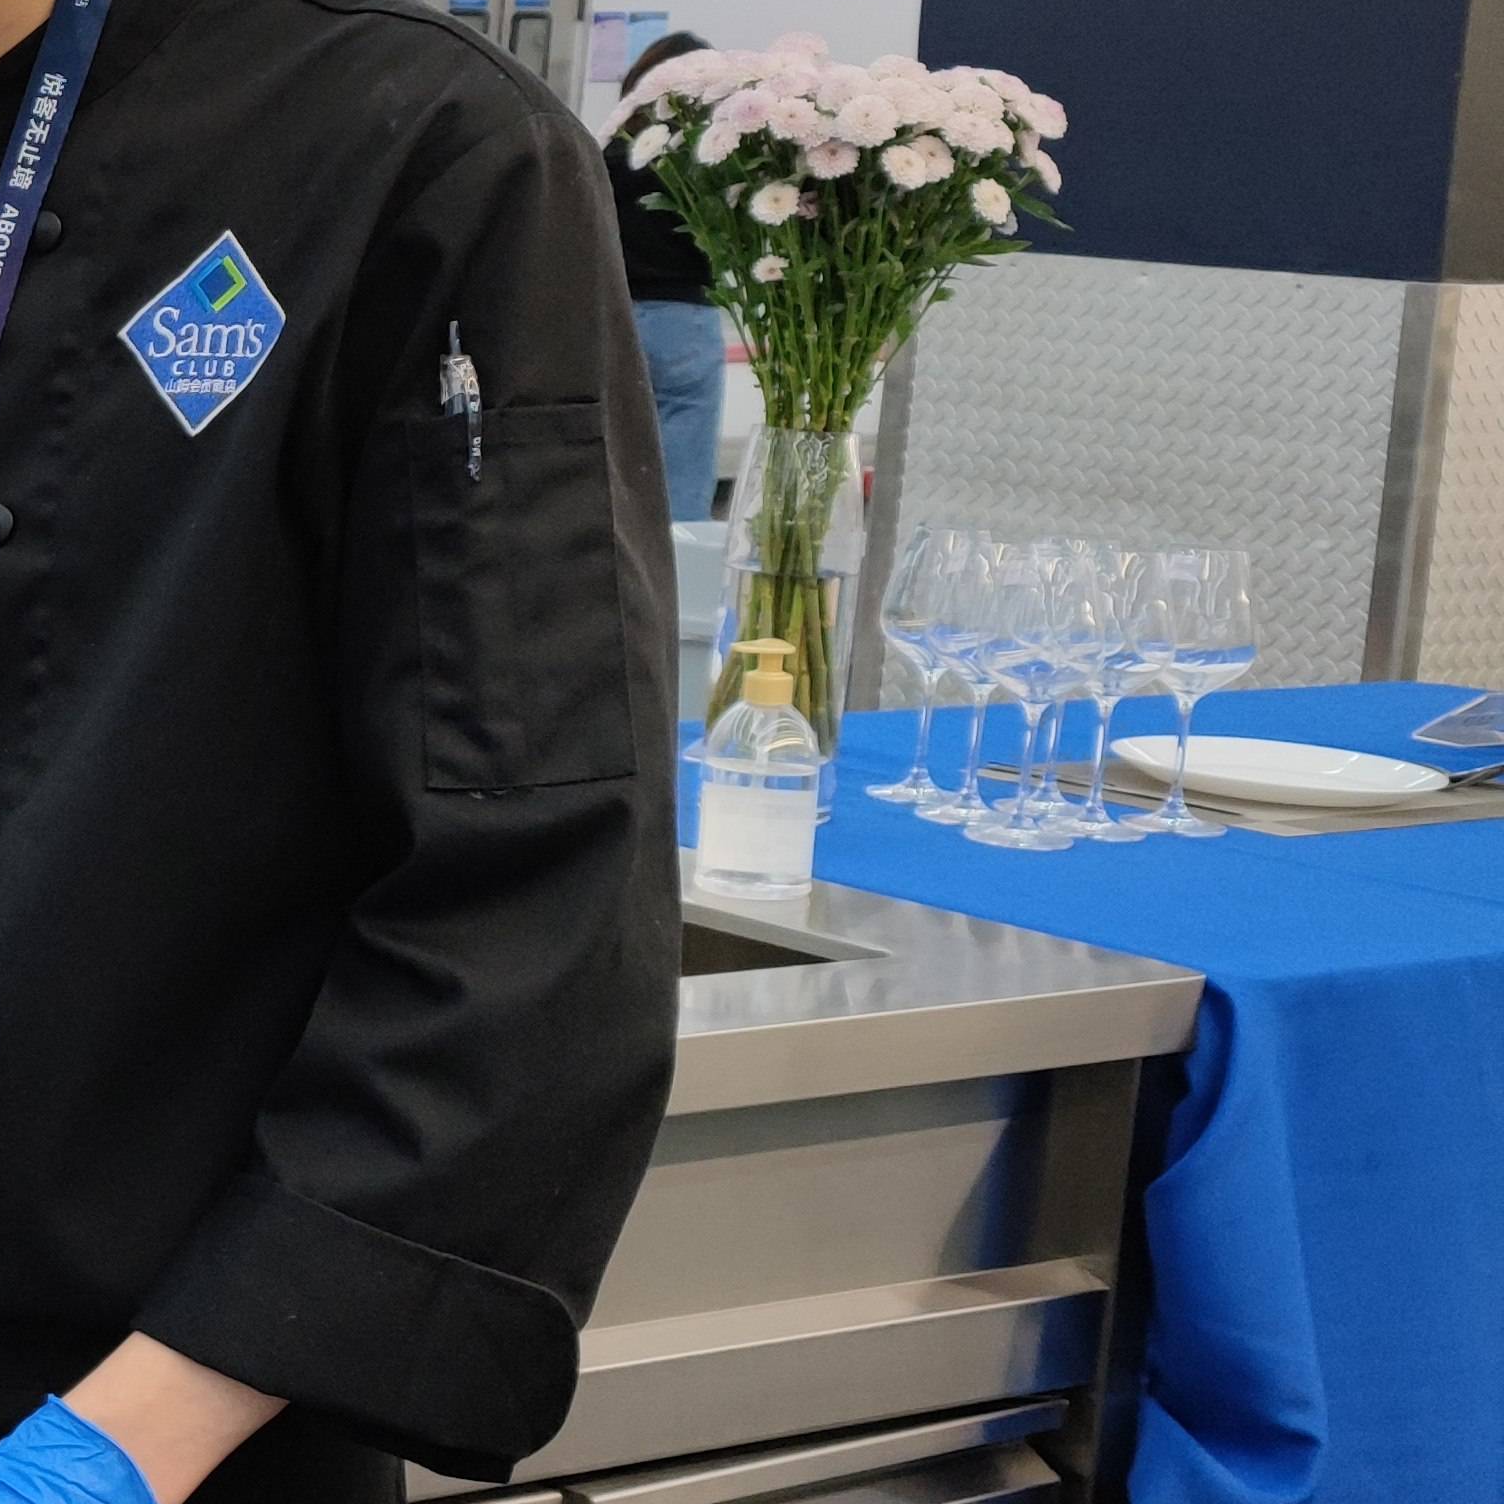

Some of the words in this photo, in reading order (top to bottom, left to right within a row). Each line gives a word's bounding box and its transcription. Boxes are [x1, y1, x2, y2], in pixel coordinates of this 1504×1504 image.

[9, 72, 68, 190] 悦客无止境
[148, 306, 266, 359] Sam's
[173, 360, 236, 377] CLUB
